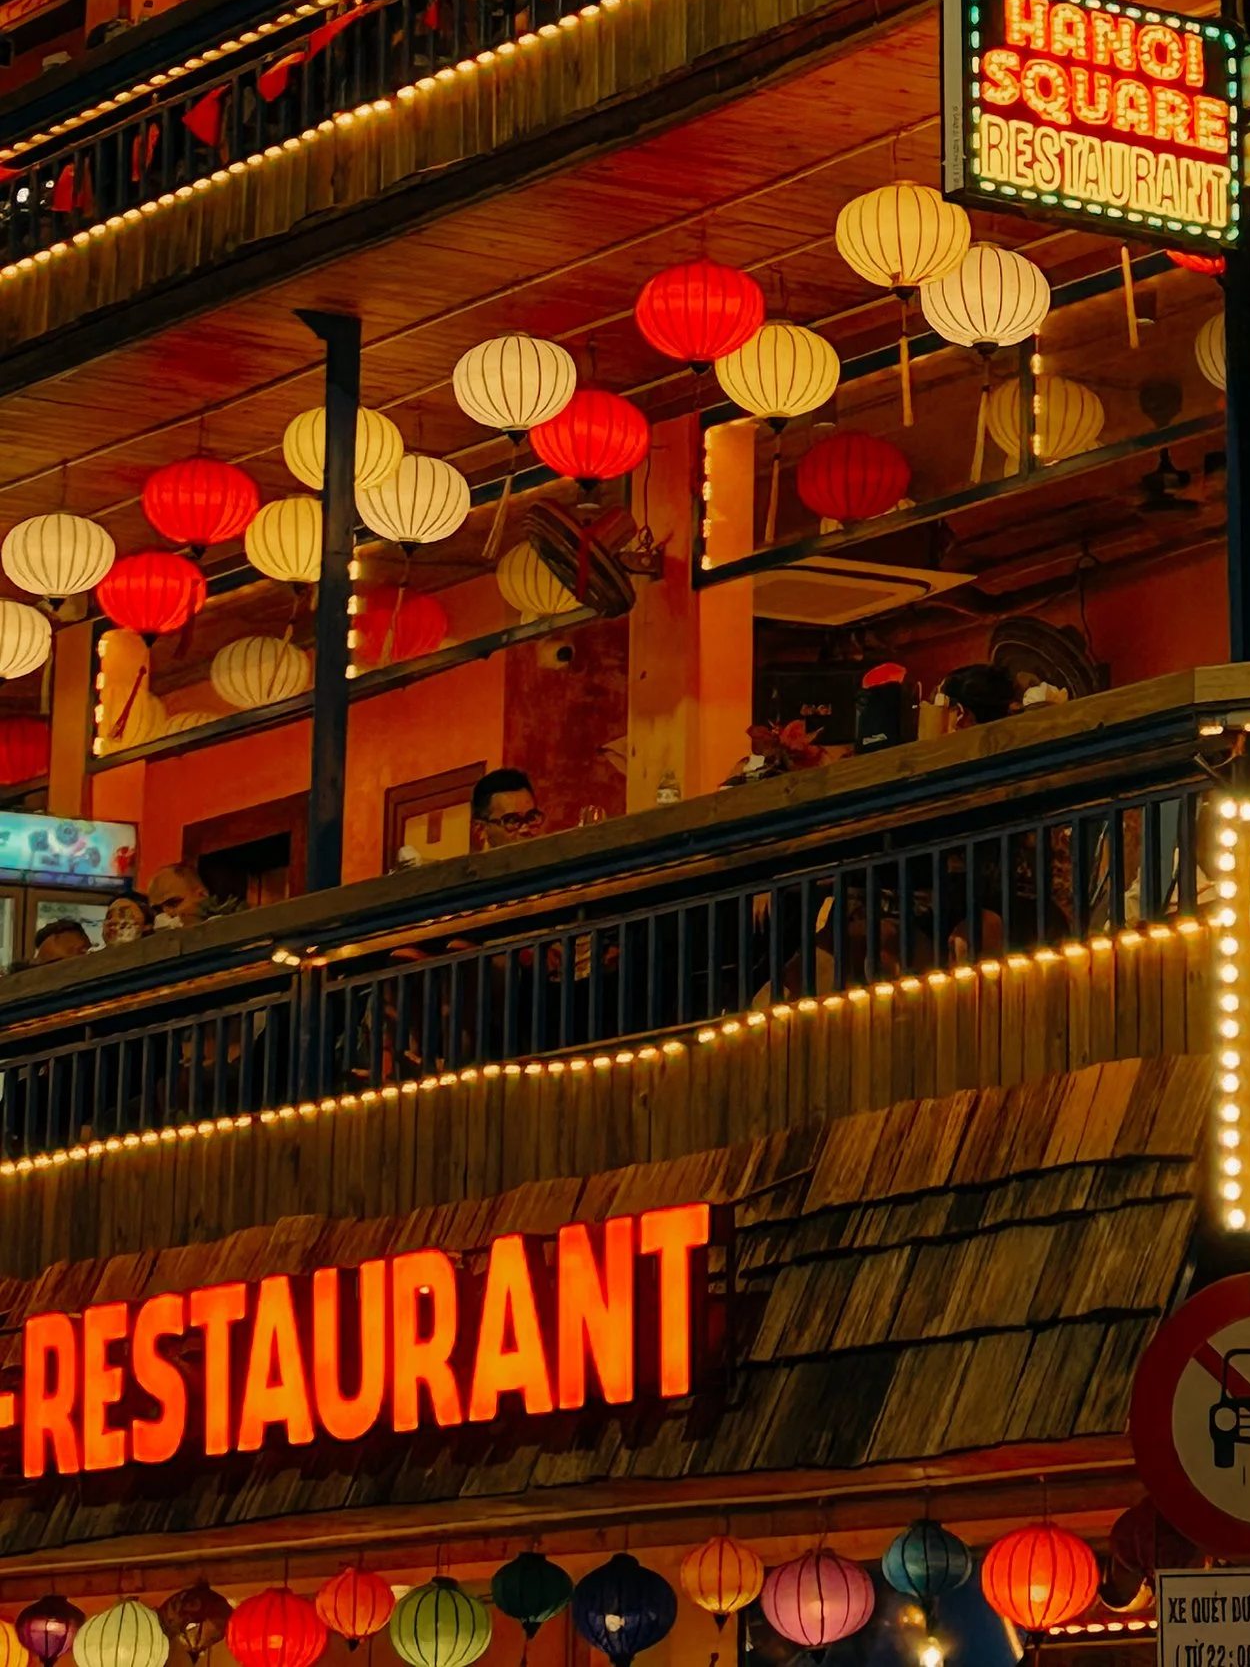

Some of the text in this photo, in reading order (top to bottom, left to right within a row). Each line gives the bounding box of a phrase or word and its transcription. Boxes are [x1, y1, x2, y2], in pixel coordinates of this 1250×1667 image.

[981, 50, 1228, 153] SQUARE
[979, 114, 1231, 227] RESTAURANT
[1168, 1597, 1187, 1623] XE
